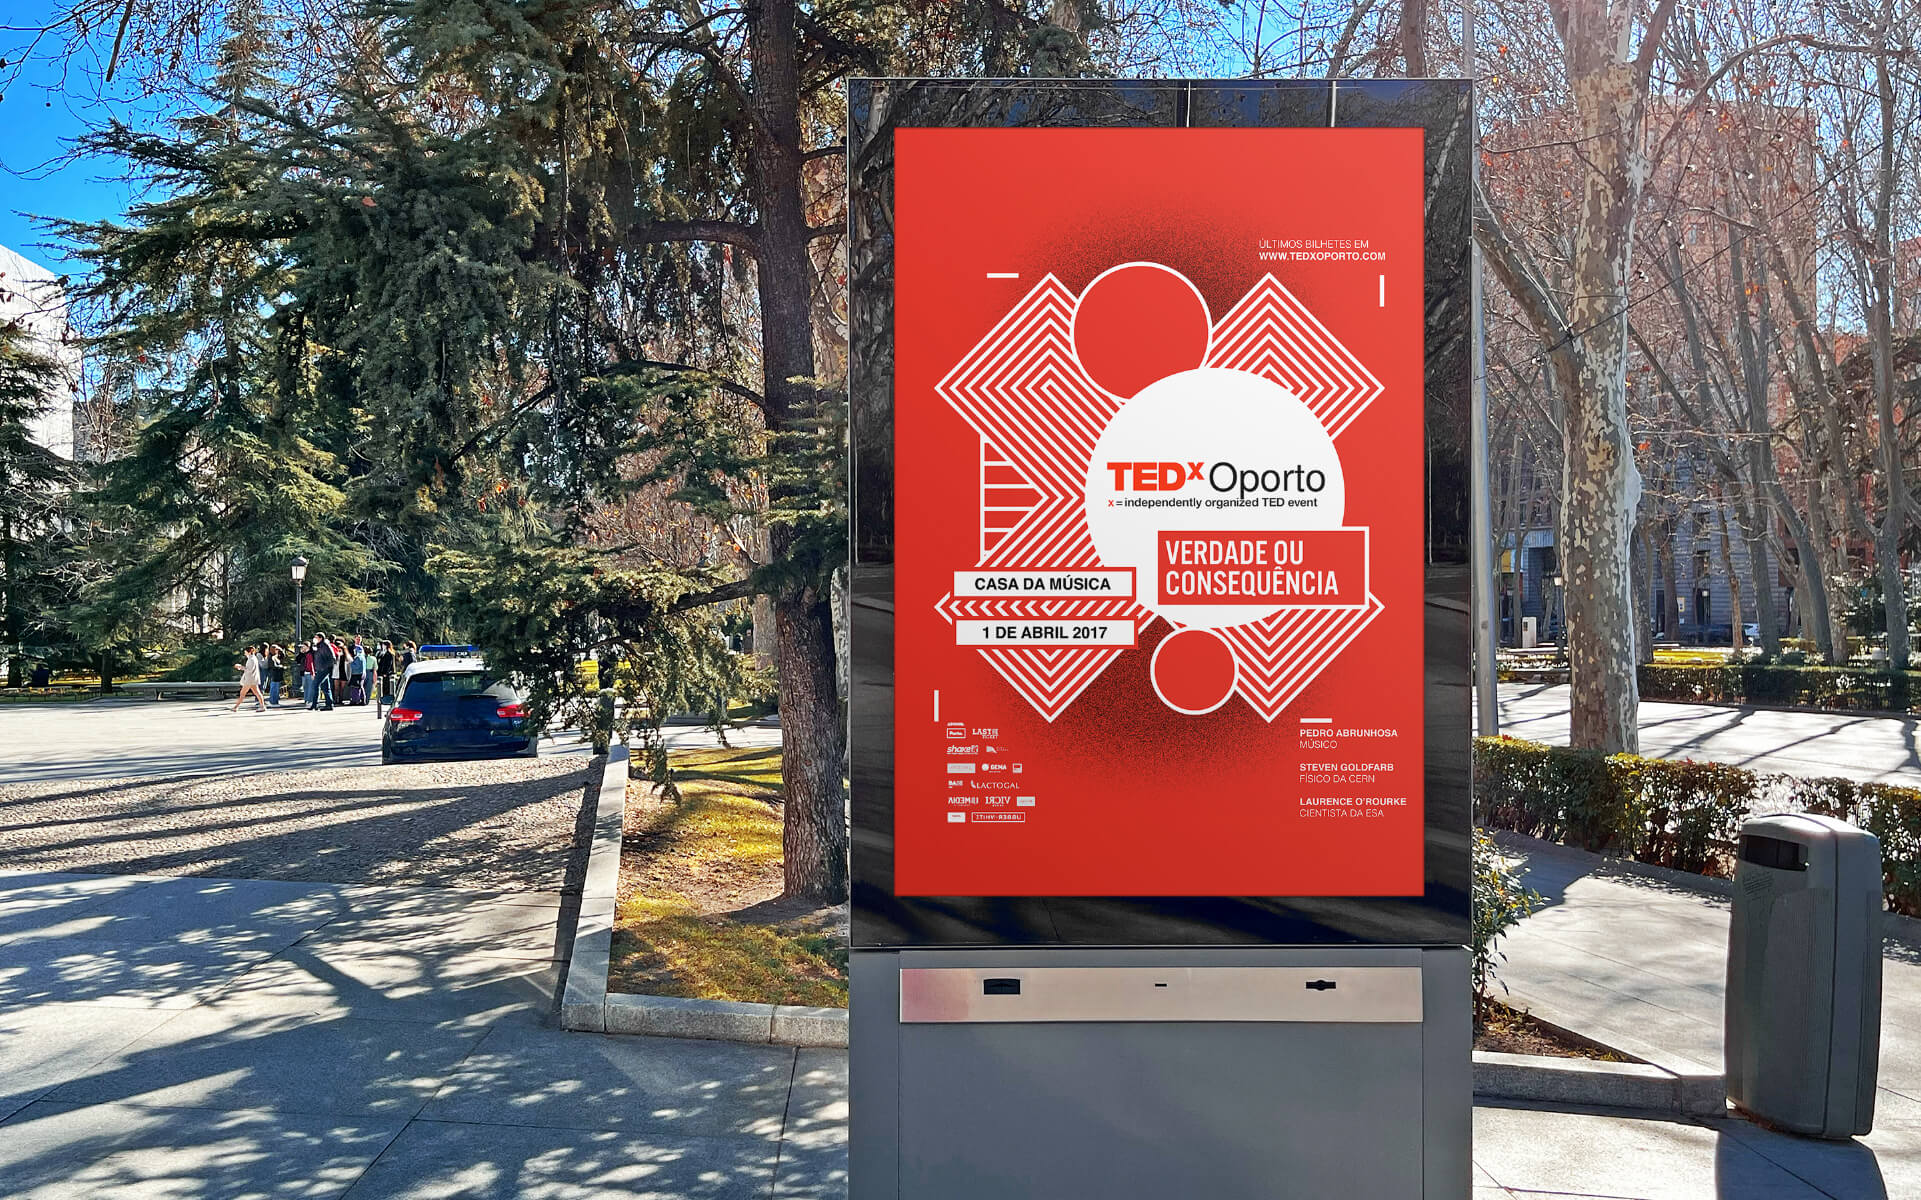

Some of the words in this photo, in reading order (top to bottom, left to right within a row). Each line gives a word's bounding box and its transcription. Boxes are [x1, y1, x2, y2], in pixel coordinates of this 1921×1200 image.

[1259, 237, 1303, 249] ÚLTIMOS
[1305, 240, 1352, 249] BILHETES
[1354, 240, 1369, 249] EM
[1259, 252, 1386, 261] WWW.TEDXOPORTO.COM
[1209, 462, 1326, 499] Oporto
[1205, 498, 1259, 510] organized
[1262, 498, 1285, 507] TED
[1288, 499, 1318, 507] event
[1165, 540, 1267, 565] VERDADE
[1274, 540, 1304, 565] OU
[974, 577, 1019, 590] CASA
[1024, 577, 1045, 590] DA
[1050, 574, 1111, 590] MÚSICA
[1166, 566, 1339, 596] CONSEQUÊNCIA
[982, 626, 989, 639] 1
[996, 626, 1017, 639] DE
[1021, 626, 1068, 639] ABRIL
[1073, 626, 1107, 639] 2017
[1300, 729, 1334, 737] PEDRO
[1336, 729, 1398, 737] ABRUNHOSA
[1300, 739, 1338, 749] MÚSICO
[1300, 763, 1338, 772] STEVEN
[1340, 763, 1394, 772] GOLDFARB
[1300, 773, 1331, 783] FÍSICO
[1333, 775, 1346, 783] DA
[1349, 775, 1375, 783] CERN
[1300, 798, 1353, 806] LAURENCE
[1300, 809, 1347, 817] CIENTISTA
[1349, 809, 1363, 817] DA
[1366, 809, 1384, 817] ESA
